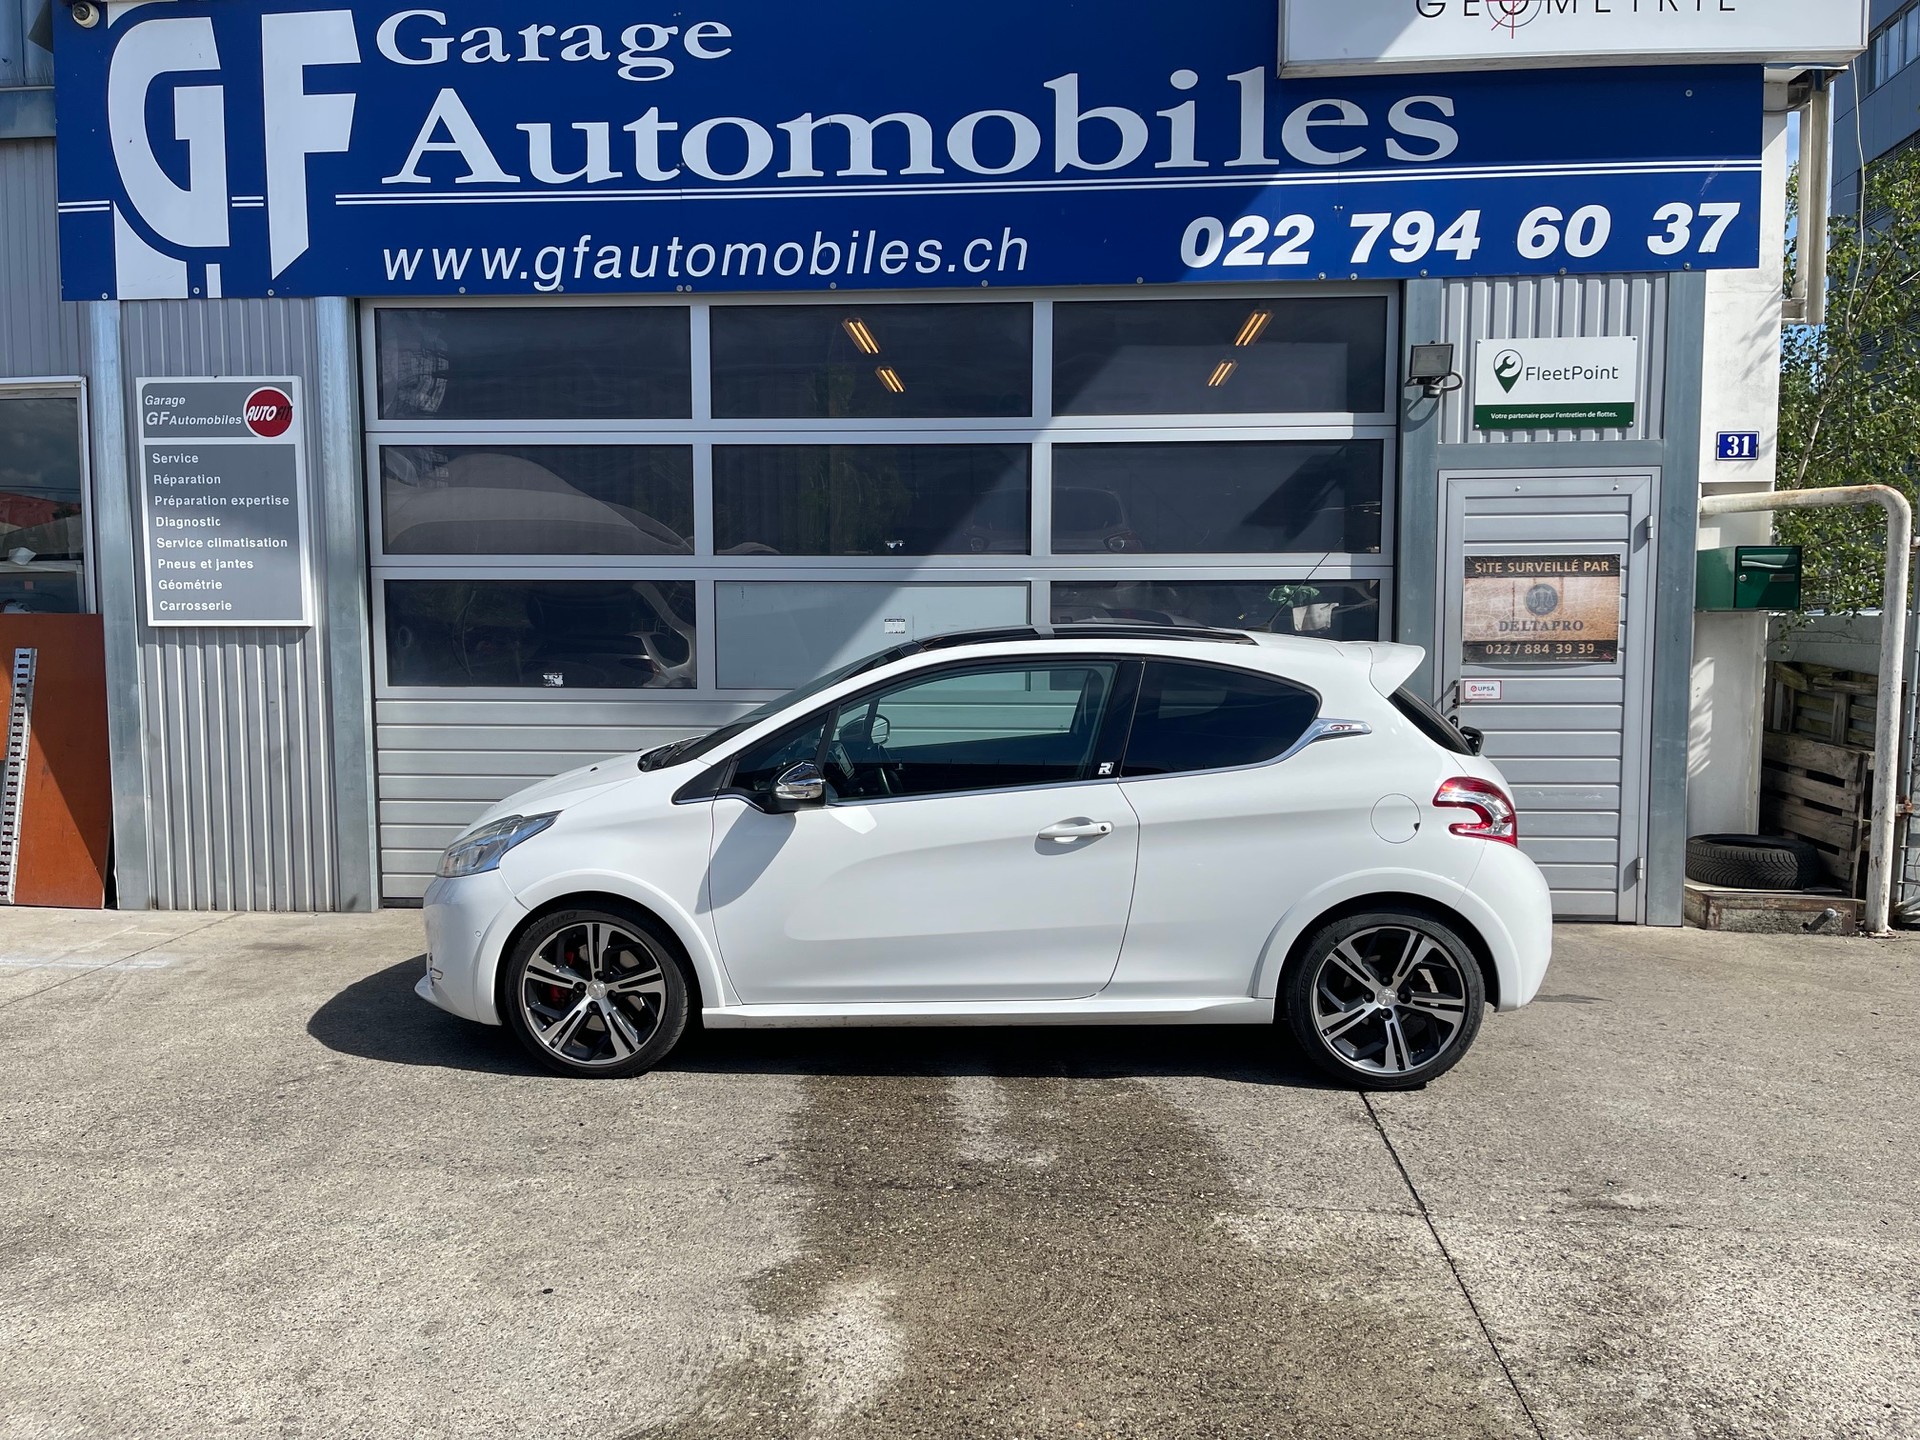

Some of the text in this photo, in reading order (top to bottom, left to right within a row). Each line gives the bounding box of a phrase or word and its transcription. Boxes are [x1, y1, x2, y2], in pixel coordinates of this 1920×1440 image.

[377, 9, 732, 82] Garage
[381, 66, 1459, 185] Automobiles
[1180, 202, 1741, 268] 022 794 60 37
[383, 226, 1028, 293] www.gfautomobiles.ch
[1525, 365, 1619, 381] FleetPoint
[145, 395, 186, 407] Garage
[1490, 412, 1508, 420] Votre
[1508, 412, 1539, 421] partenaire
[1540, 412, 1555, 420] pour
[1726, 435, 1751, 457] 31
[152, 452, 199, 464] Service
[153, 473, 221, 487] Réparation
[154, 495, 290, 509] Préparation expertise
[155, 516, 221, 530] Diagnostic
[156, 537, 288, 549] Service climatisation
[158, 558, 254, 571] Pneus et jantes
[1474, 559, 1610, 573] SITE SURVEILLÉ PAR
[158, 579, 223, 590] Géométrie
[159, 600, 232, 611] Carrosserie
[1498, 620, 1584, 632] DELTAPRO
[1486, 644, 1511, 655] 022
[1524, 644, 1550, 654] 884
[1555, 643, 1573, 654] 39
[1578, 643, 1595, 654] 39
